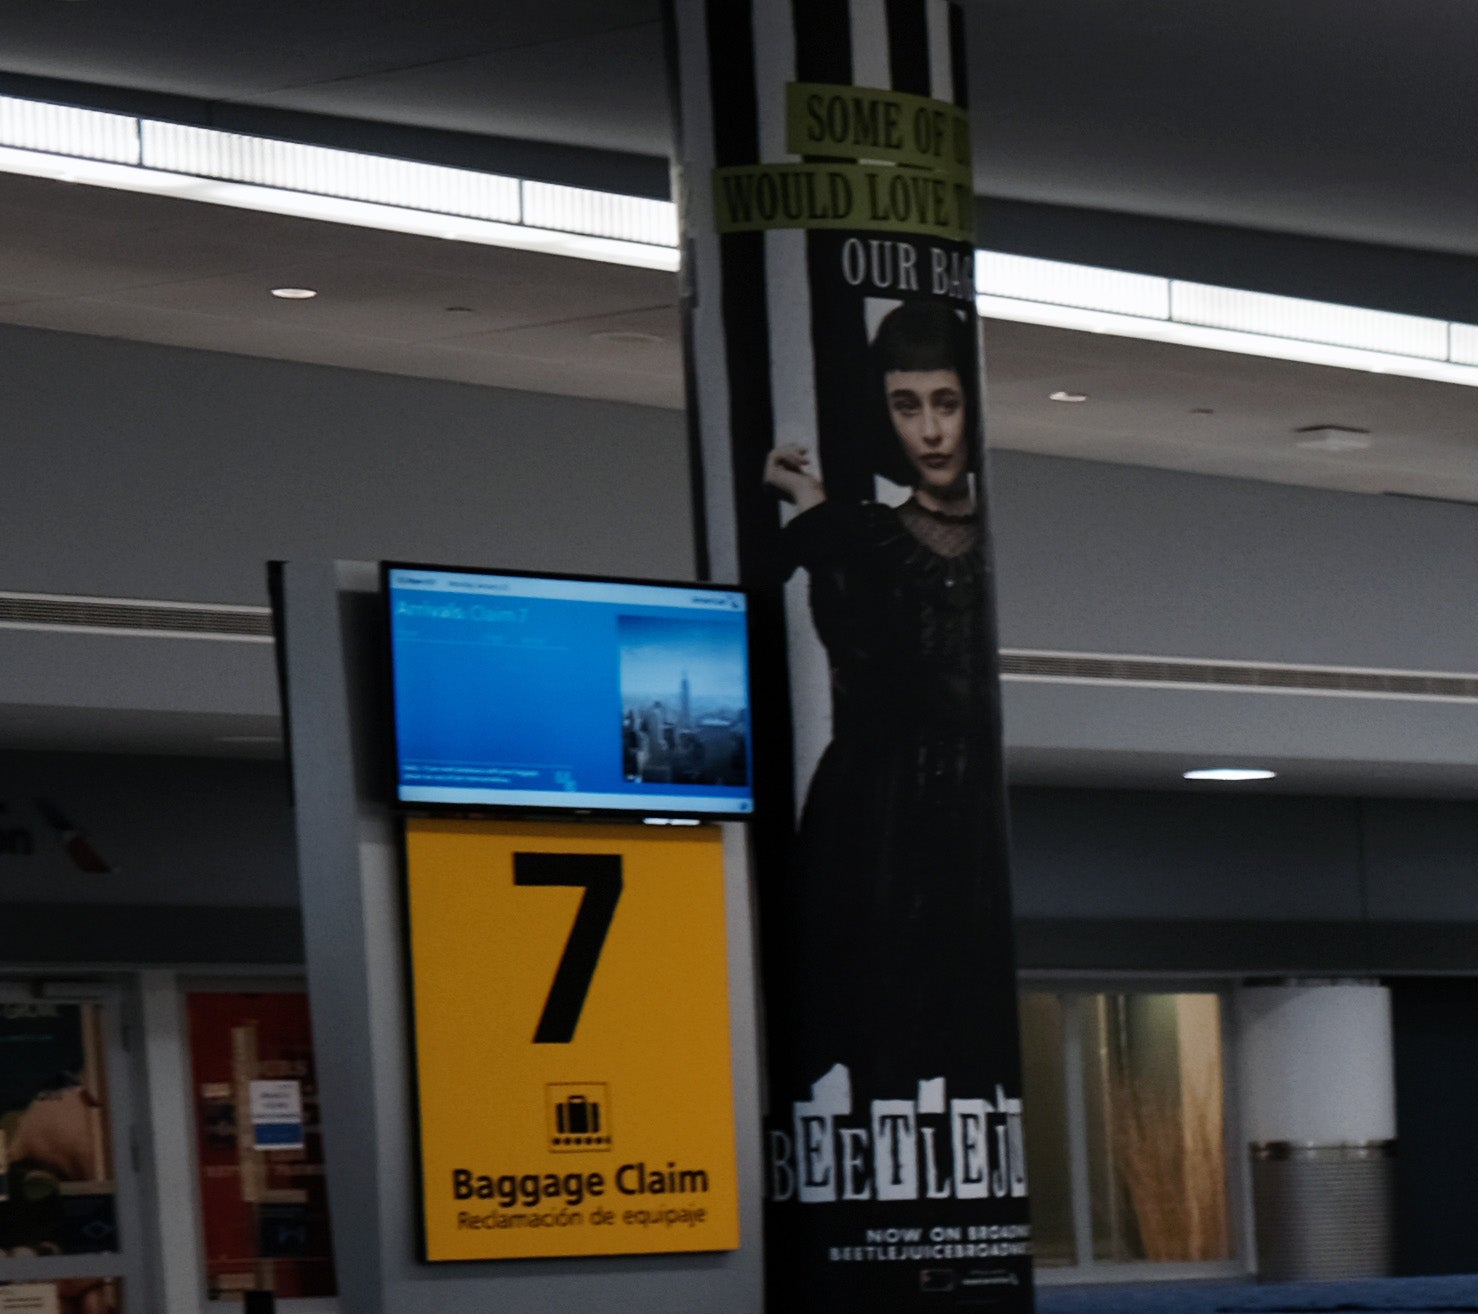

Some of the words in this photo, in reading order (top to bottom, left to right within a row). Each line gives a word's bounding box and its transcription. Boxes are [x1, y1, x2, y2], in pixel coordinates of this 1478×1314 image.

[807, 95, 903, 149] SOME
[914, 106, 945, 157] OF
[721, 171, 853, 223] WOULD
[866, 172, 947, 228] LOVE
[841, 237, 919, 291] OUR
[512, 851, 625, 1044] 7
[453, 1168, 604, 1207] Baggage
[615, 1162, 709, 1195] Claim
[456, 1208, 584, 1230] Reclamación
[589, 1206, 614, 1227] de
[622, 1204, 706, 1228] equipaje
[865, 1227, 922, 1243] NOW
[929, 1225, 962, 1241] ON
